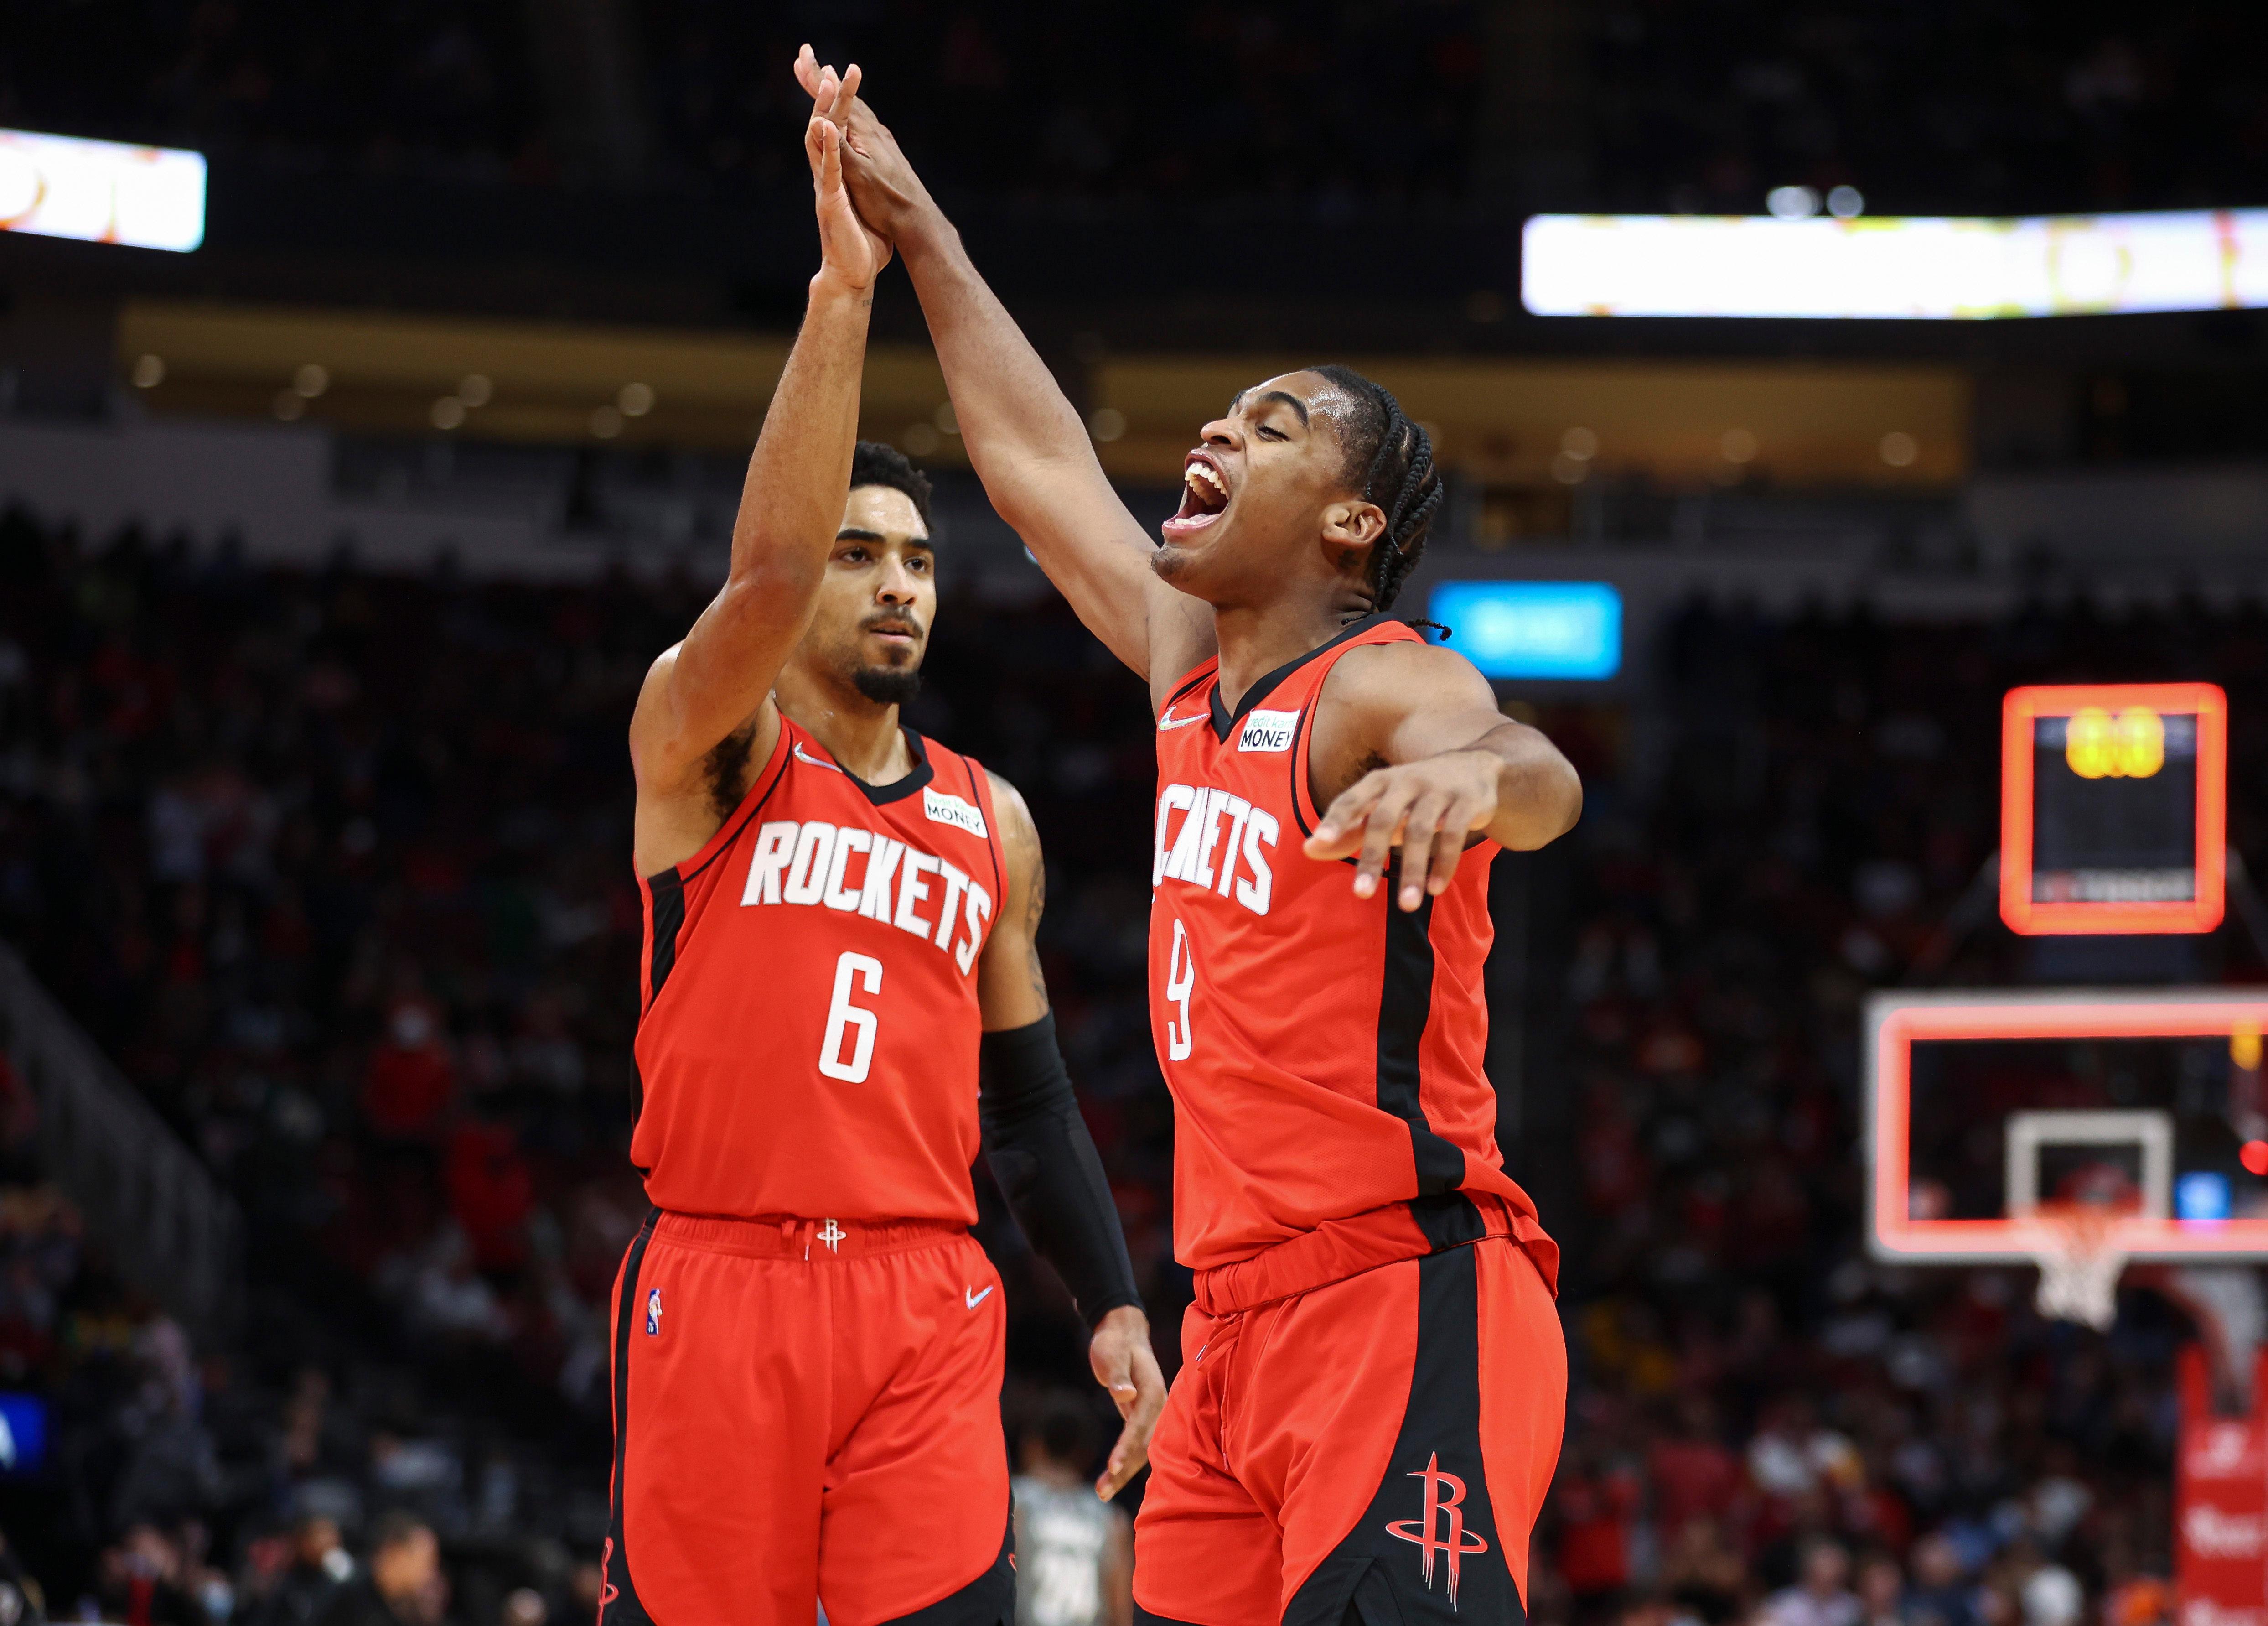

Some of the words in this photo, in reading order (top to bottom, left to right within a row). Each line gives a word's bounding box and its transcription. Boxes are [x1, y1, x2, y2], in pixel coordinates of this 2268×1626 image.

[1241, 729, 1294, 748] MONEY
[927, 803, 979, 831] MONEY
[1152, 784, 1279, 916] CKETS
[740, 820, 992, 977] ROCKETS
[818, 951, 884, 1084] 6
[1166, 917, 1195, 1061] 9
